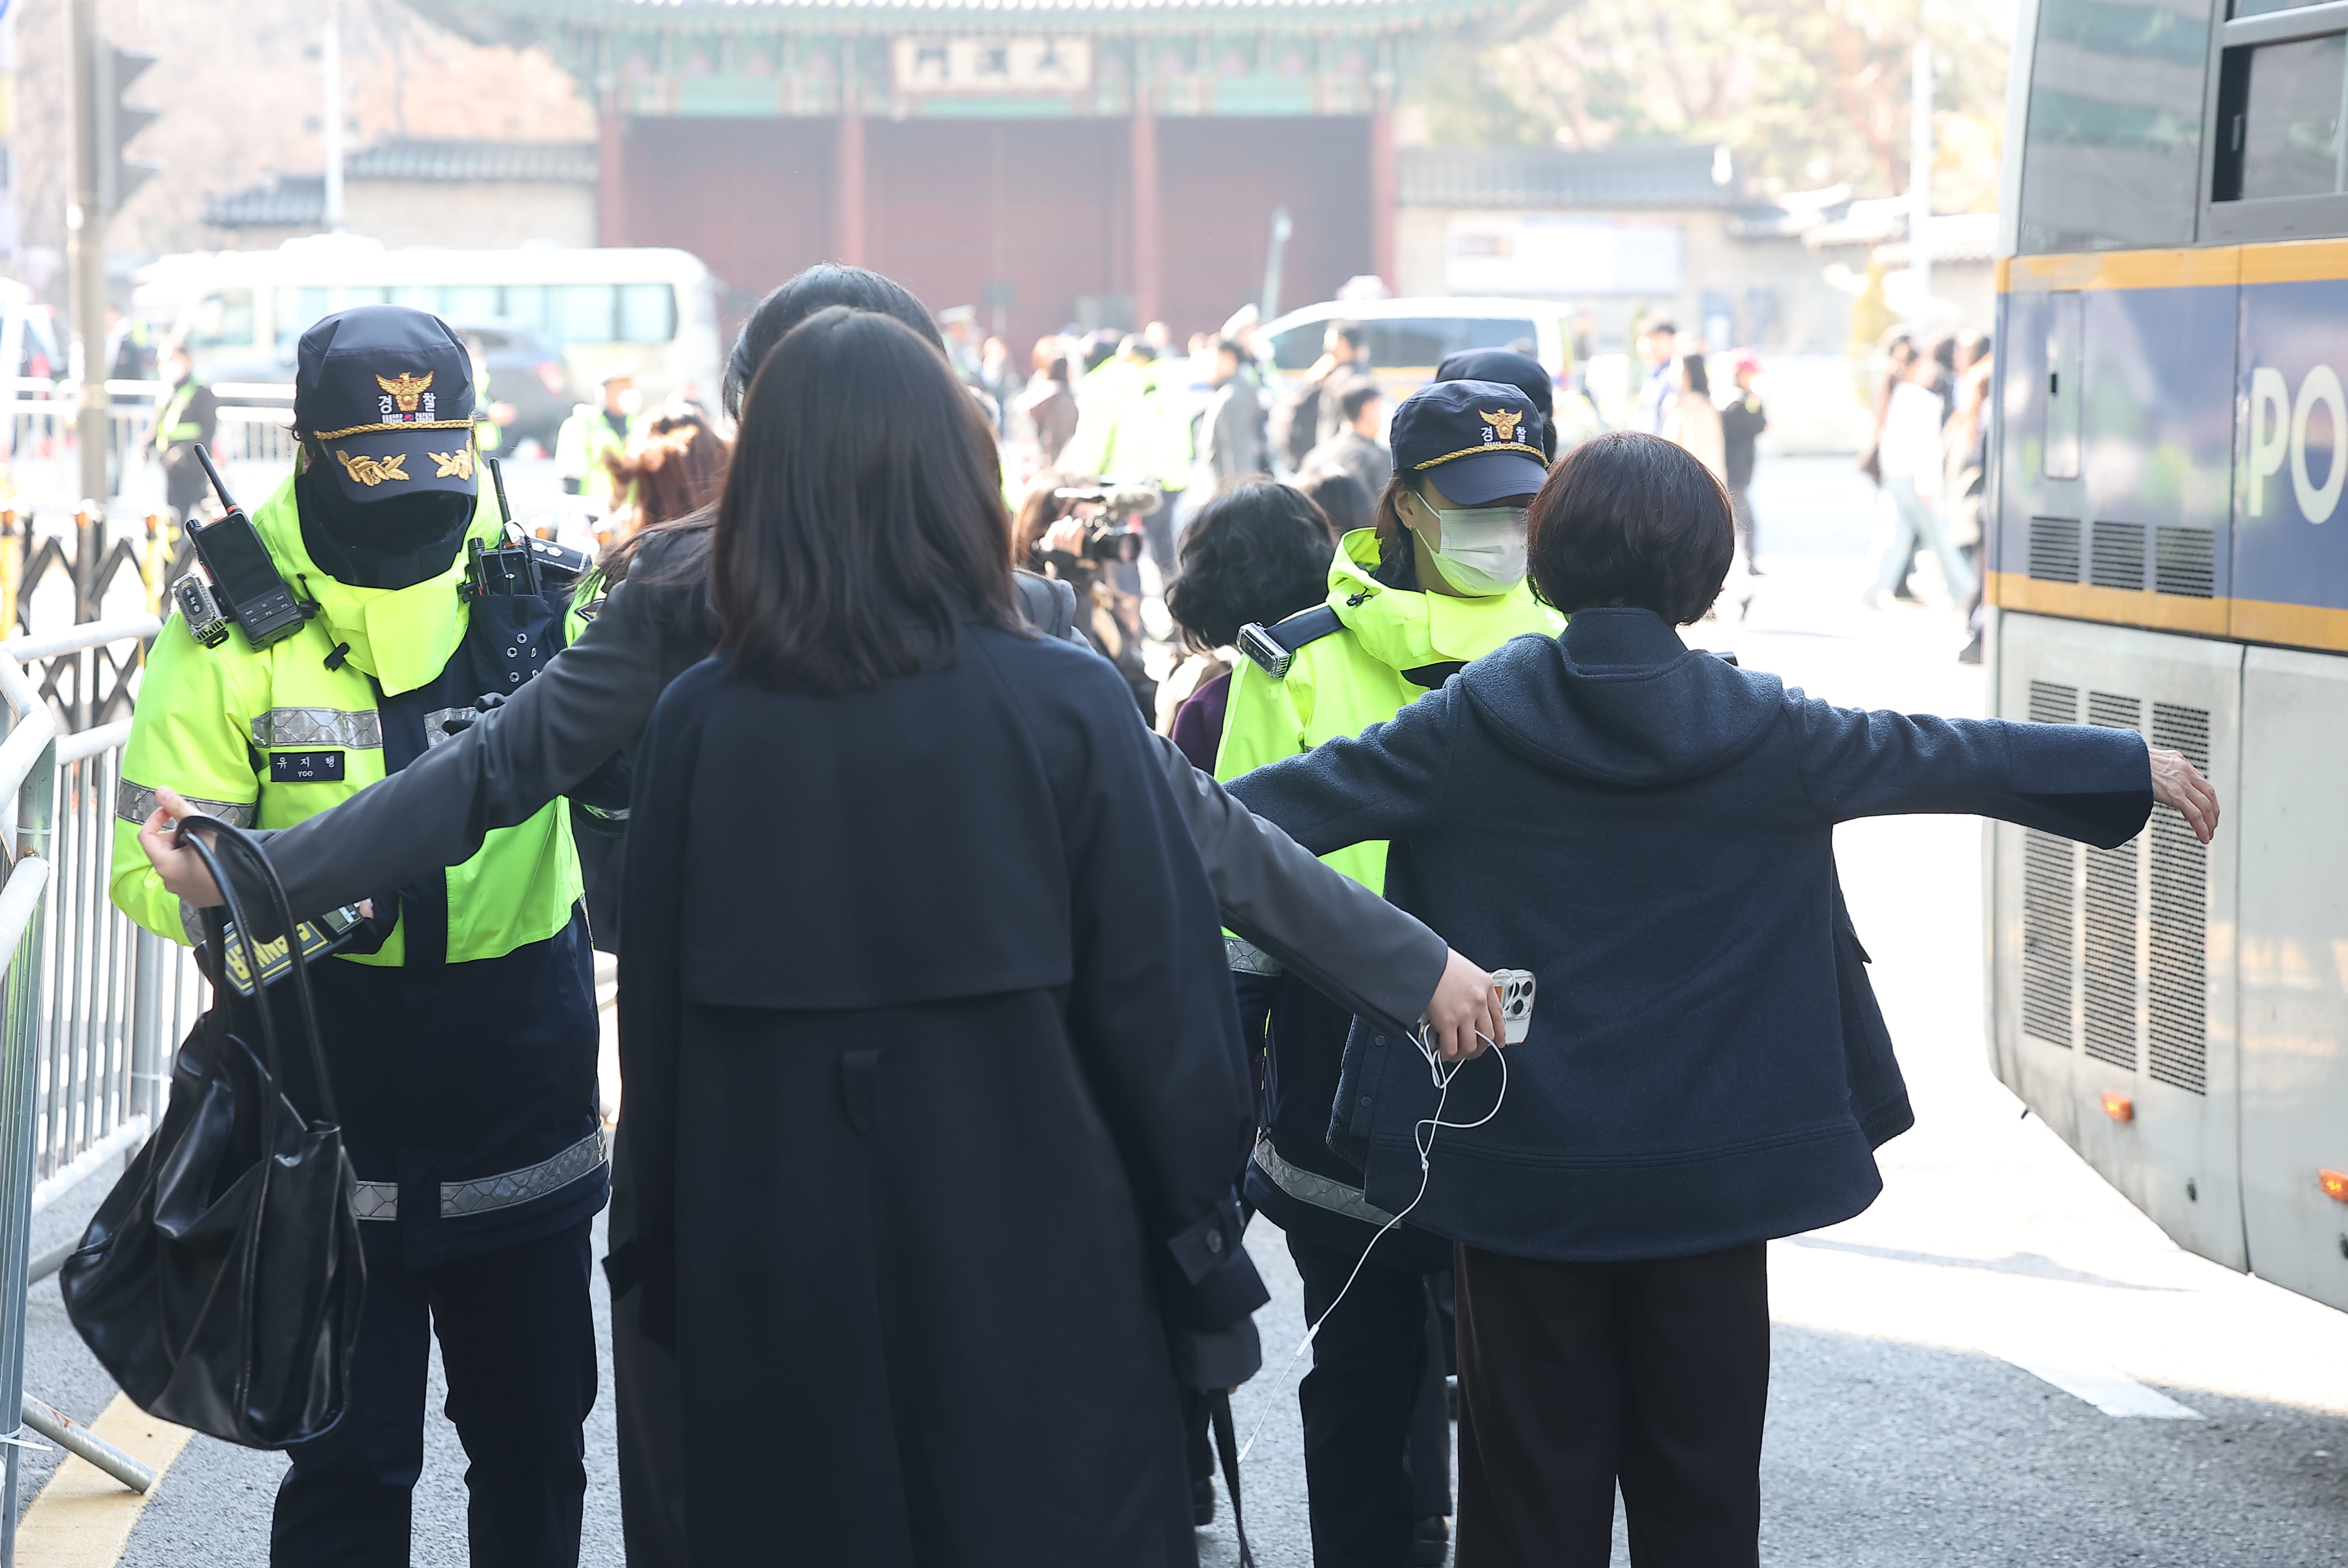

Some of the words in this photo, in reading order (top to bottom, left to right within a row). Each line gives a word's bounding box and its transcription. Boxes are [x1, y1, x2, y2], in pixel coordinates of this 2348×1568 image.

[378, 392, 437, 414] 경찰
[1480, 426, 1527, 443] 경찰
[2248, 364, 2348, 525] PO
